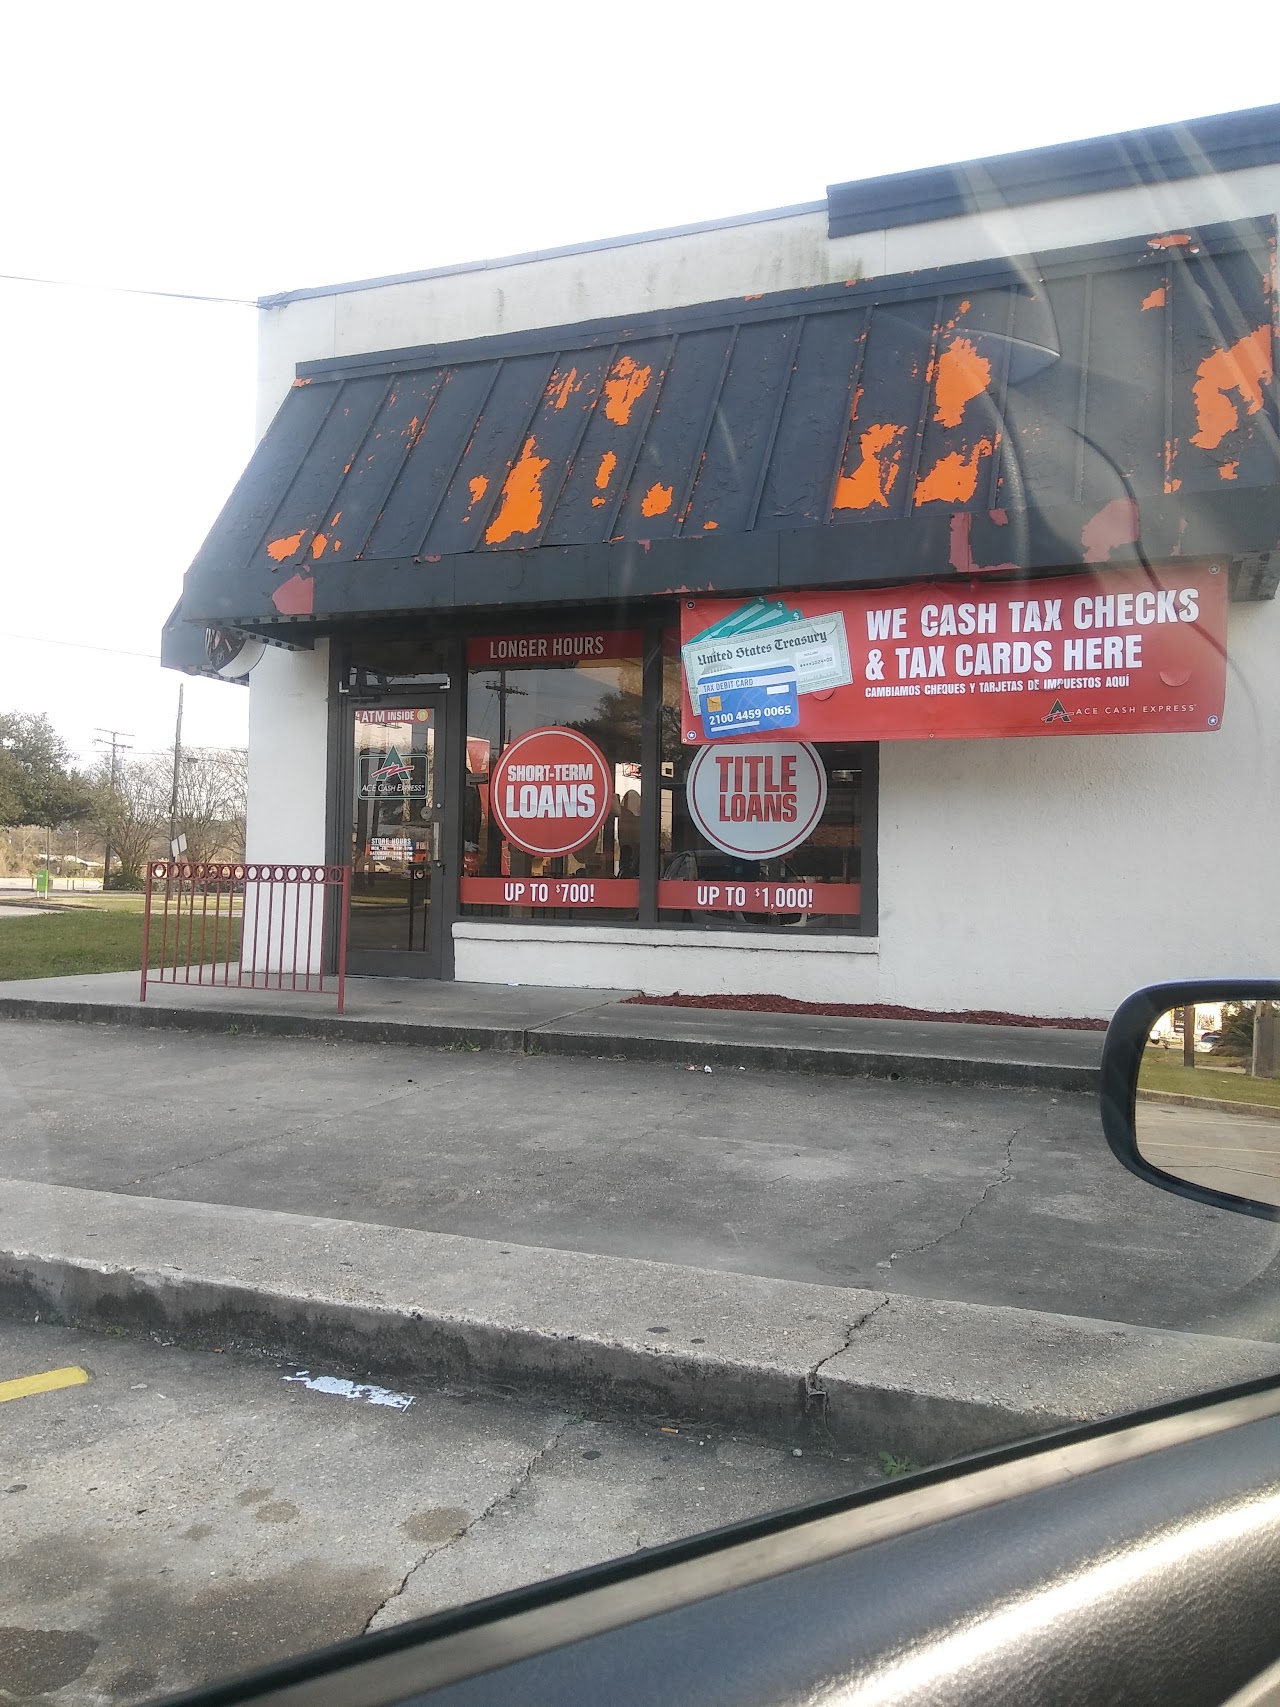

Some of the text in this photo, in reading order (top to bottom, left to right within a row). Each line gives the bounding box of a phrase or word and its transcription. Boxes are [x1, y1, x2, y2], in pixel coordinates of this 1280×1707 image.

[866, 588, 1200, 641] WE CASH TAX CHECKS
[490, 636, 604, 659] LONGER HOURS
[698, 632, 828, 666] United States Treasury
[865, 634, 1143, 681] & TAX CARDS HERE
[703, 678, 754, 692] TAX DEBIT CARD
[865, 684, 920, 698] CAMBIAMOS
[924, 683, 966, 696] CHEQUES
[969, 682, 976, 694] Y
[979, 680, 1024, 693] TARJETAS
[1028, 680, 1040, 690] DE
[1044, 678, 1102, 690] IMPUESTOS
[362, 710, 414, 722] ATM INSIDE
[709, 705, 791, 726] 2100 4459 0065
[508, 764, 593, 782] SHORT-TERM
[716, 756, 797, 792] TITLE
[506, 784, 596, 818] LOANS
[719, 794, 798, 822] LOANS
[504, 883, 595, 902] UP TO $700!
[697, 886, 813, 909] UP TO $1,000!
